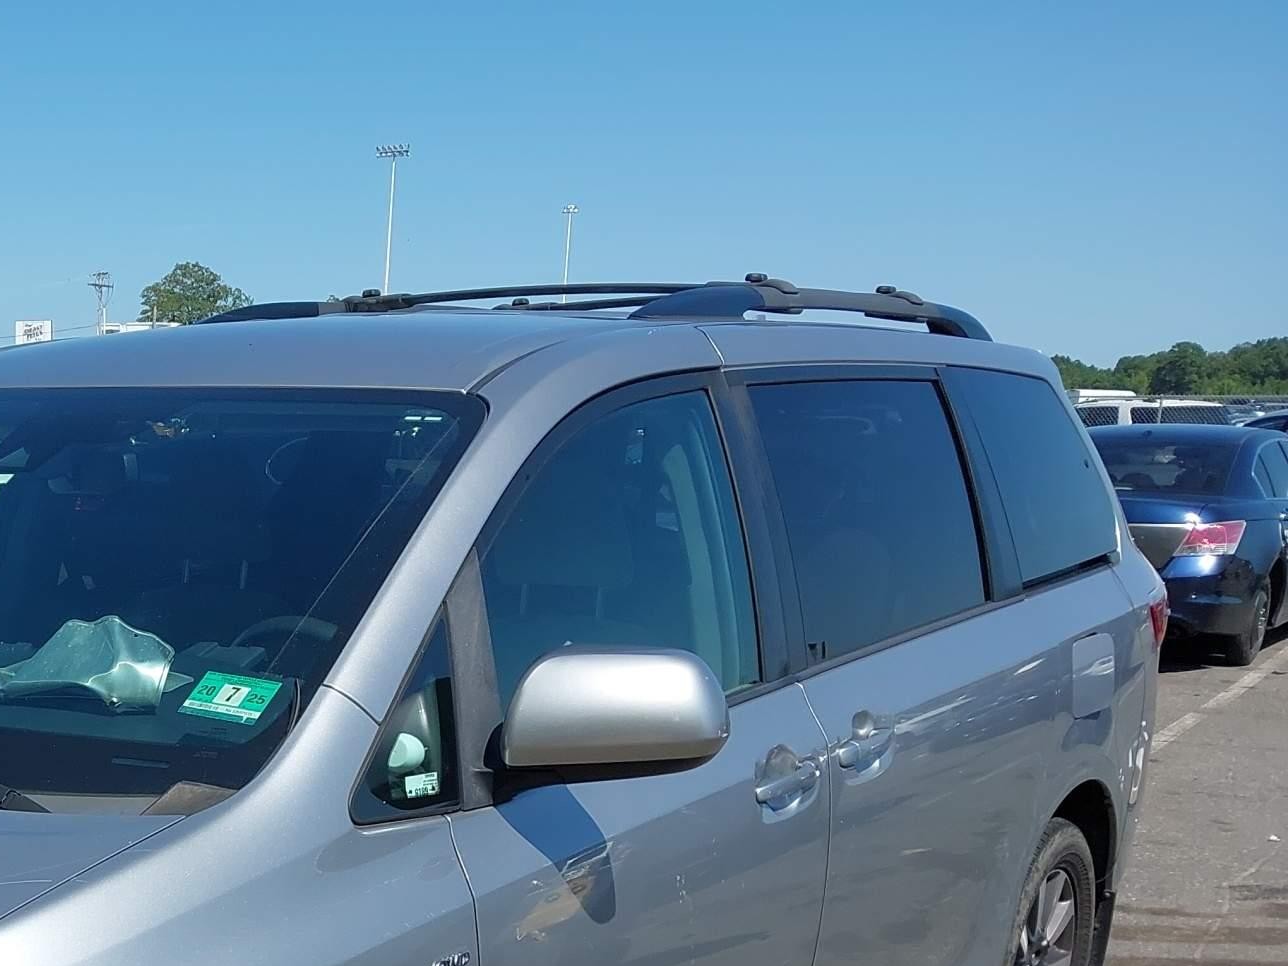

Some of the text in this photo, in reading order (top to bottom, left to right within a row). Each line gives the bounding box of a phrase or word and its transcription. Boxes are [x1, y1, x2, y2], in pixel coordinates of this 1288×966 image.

[197, 685, 266, 704] 20 7 25
